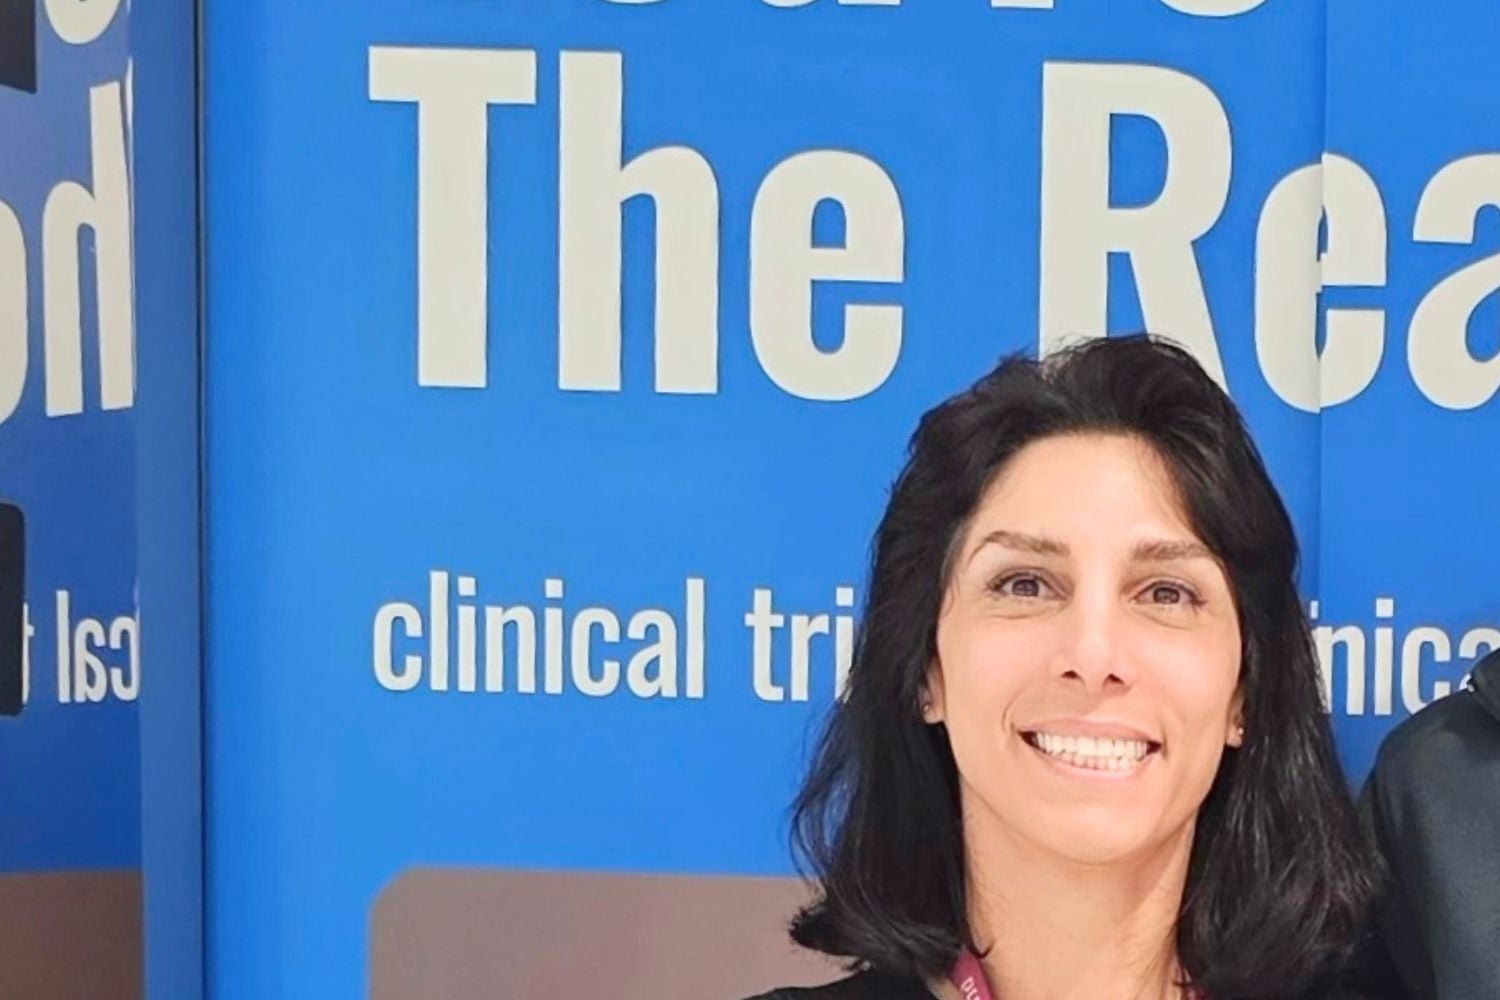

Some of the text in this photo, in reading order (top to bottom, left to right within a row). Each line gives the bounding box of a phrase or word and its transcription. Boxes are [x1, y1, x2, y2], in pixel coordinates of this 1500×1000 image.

[368, 44, 904, 402] The
[372, 570, 704, 699] clinical
[744, 586, 854, 703] tri
